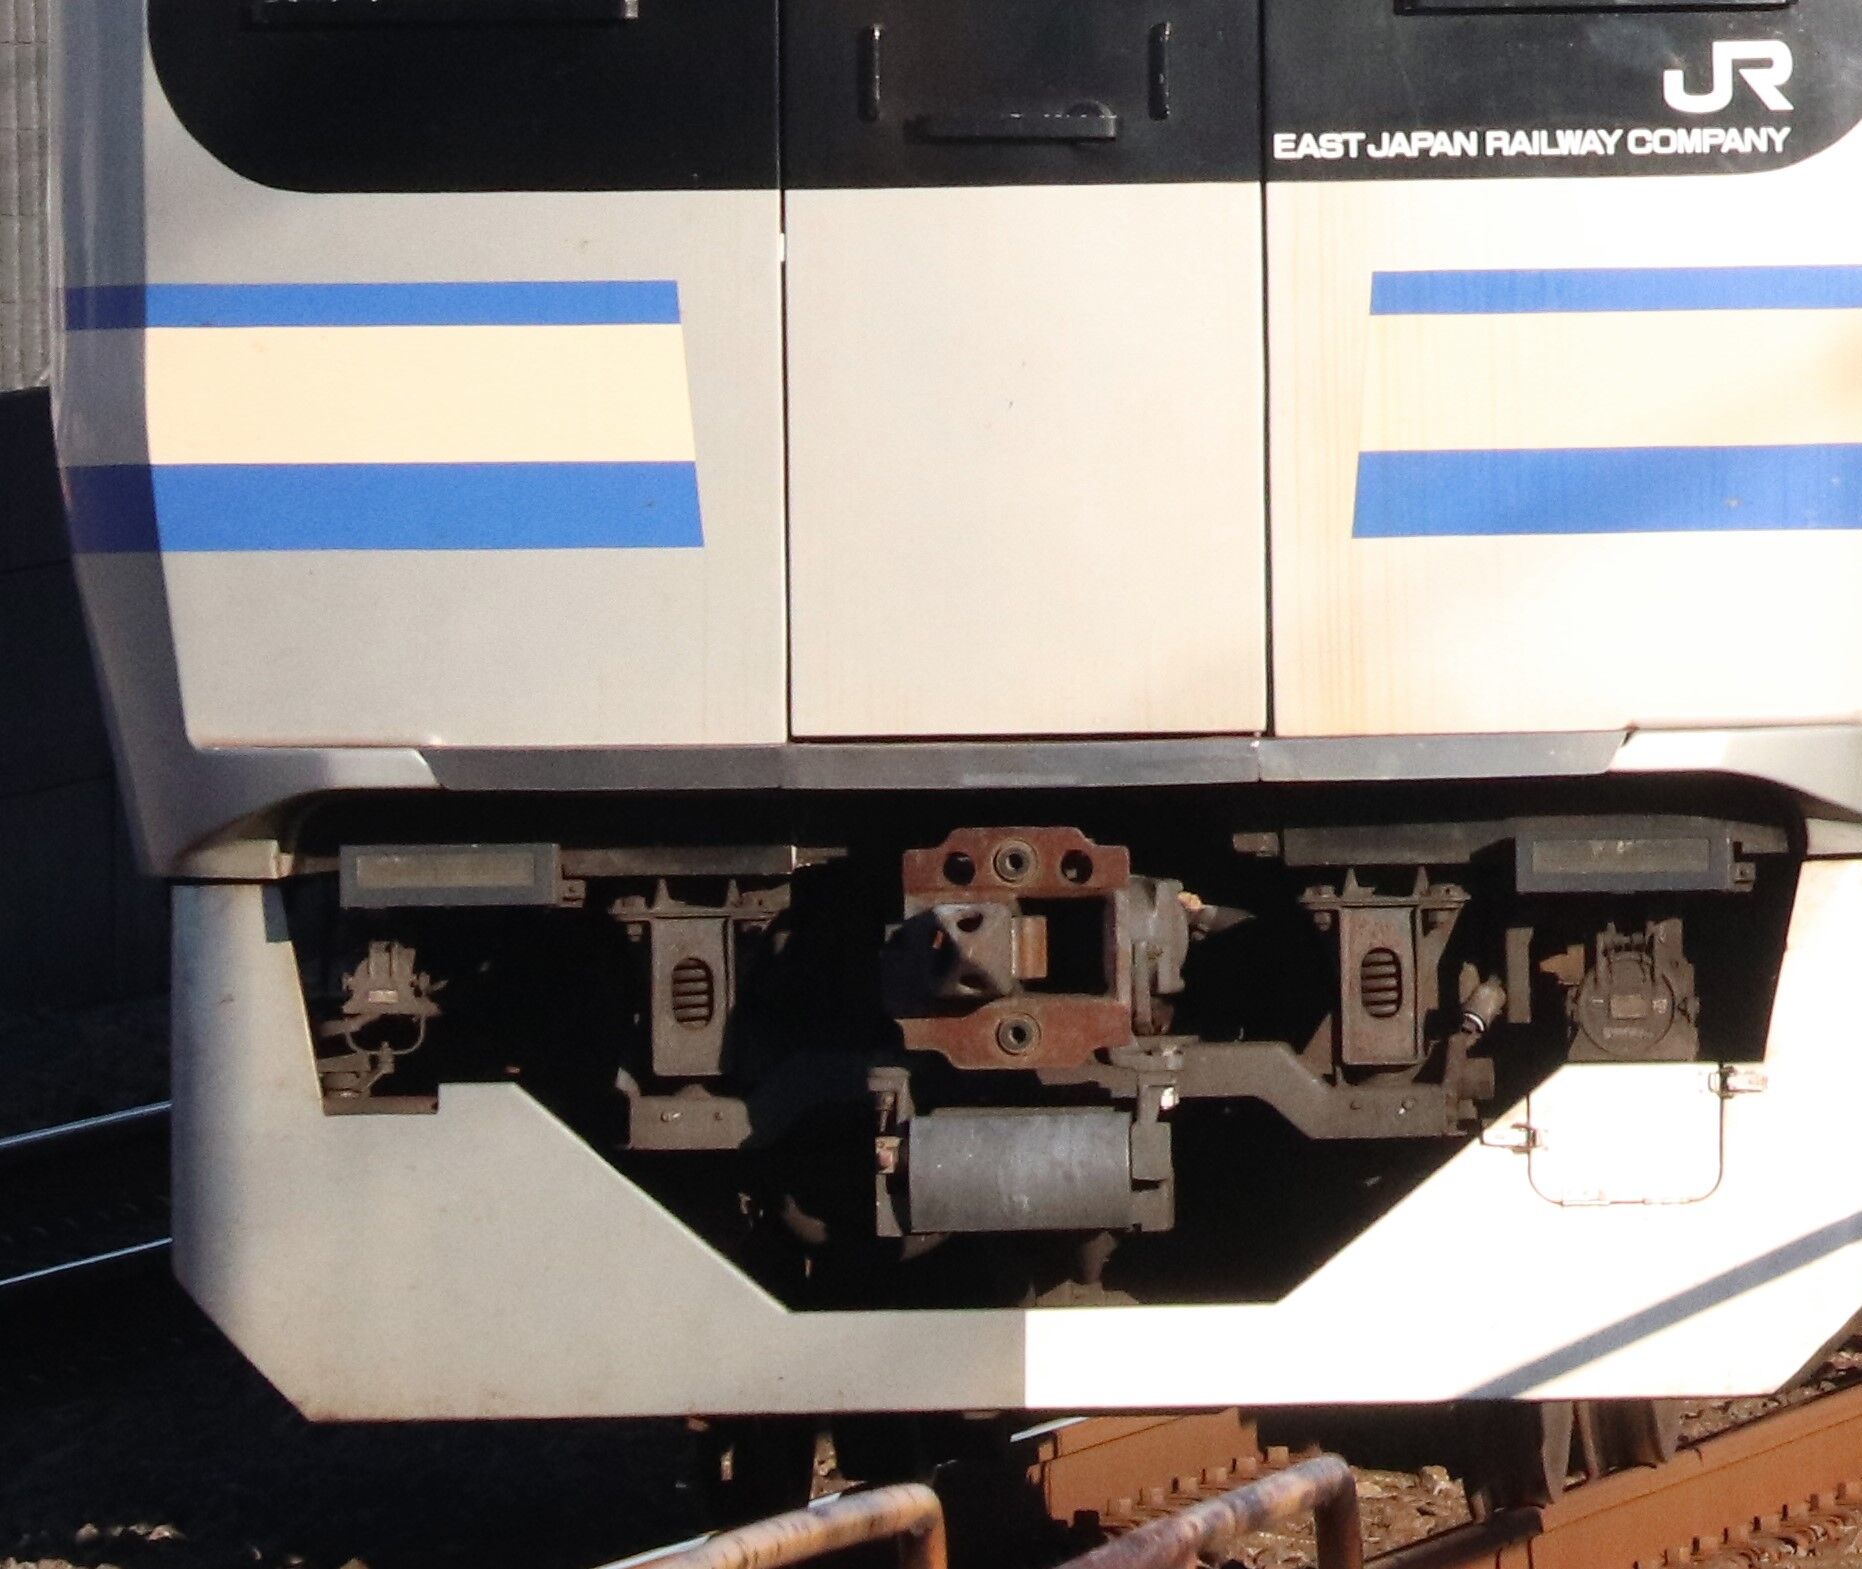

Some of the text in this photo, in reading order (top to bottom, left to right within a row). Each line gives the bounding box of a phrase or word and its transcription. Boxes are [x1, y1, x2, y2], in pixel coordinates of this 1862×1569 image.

[1663, 39, 1794, 114] JR
[1273, 127, 1790, 159] EAST JAPAN RAILWAY COMPANY
